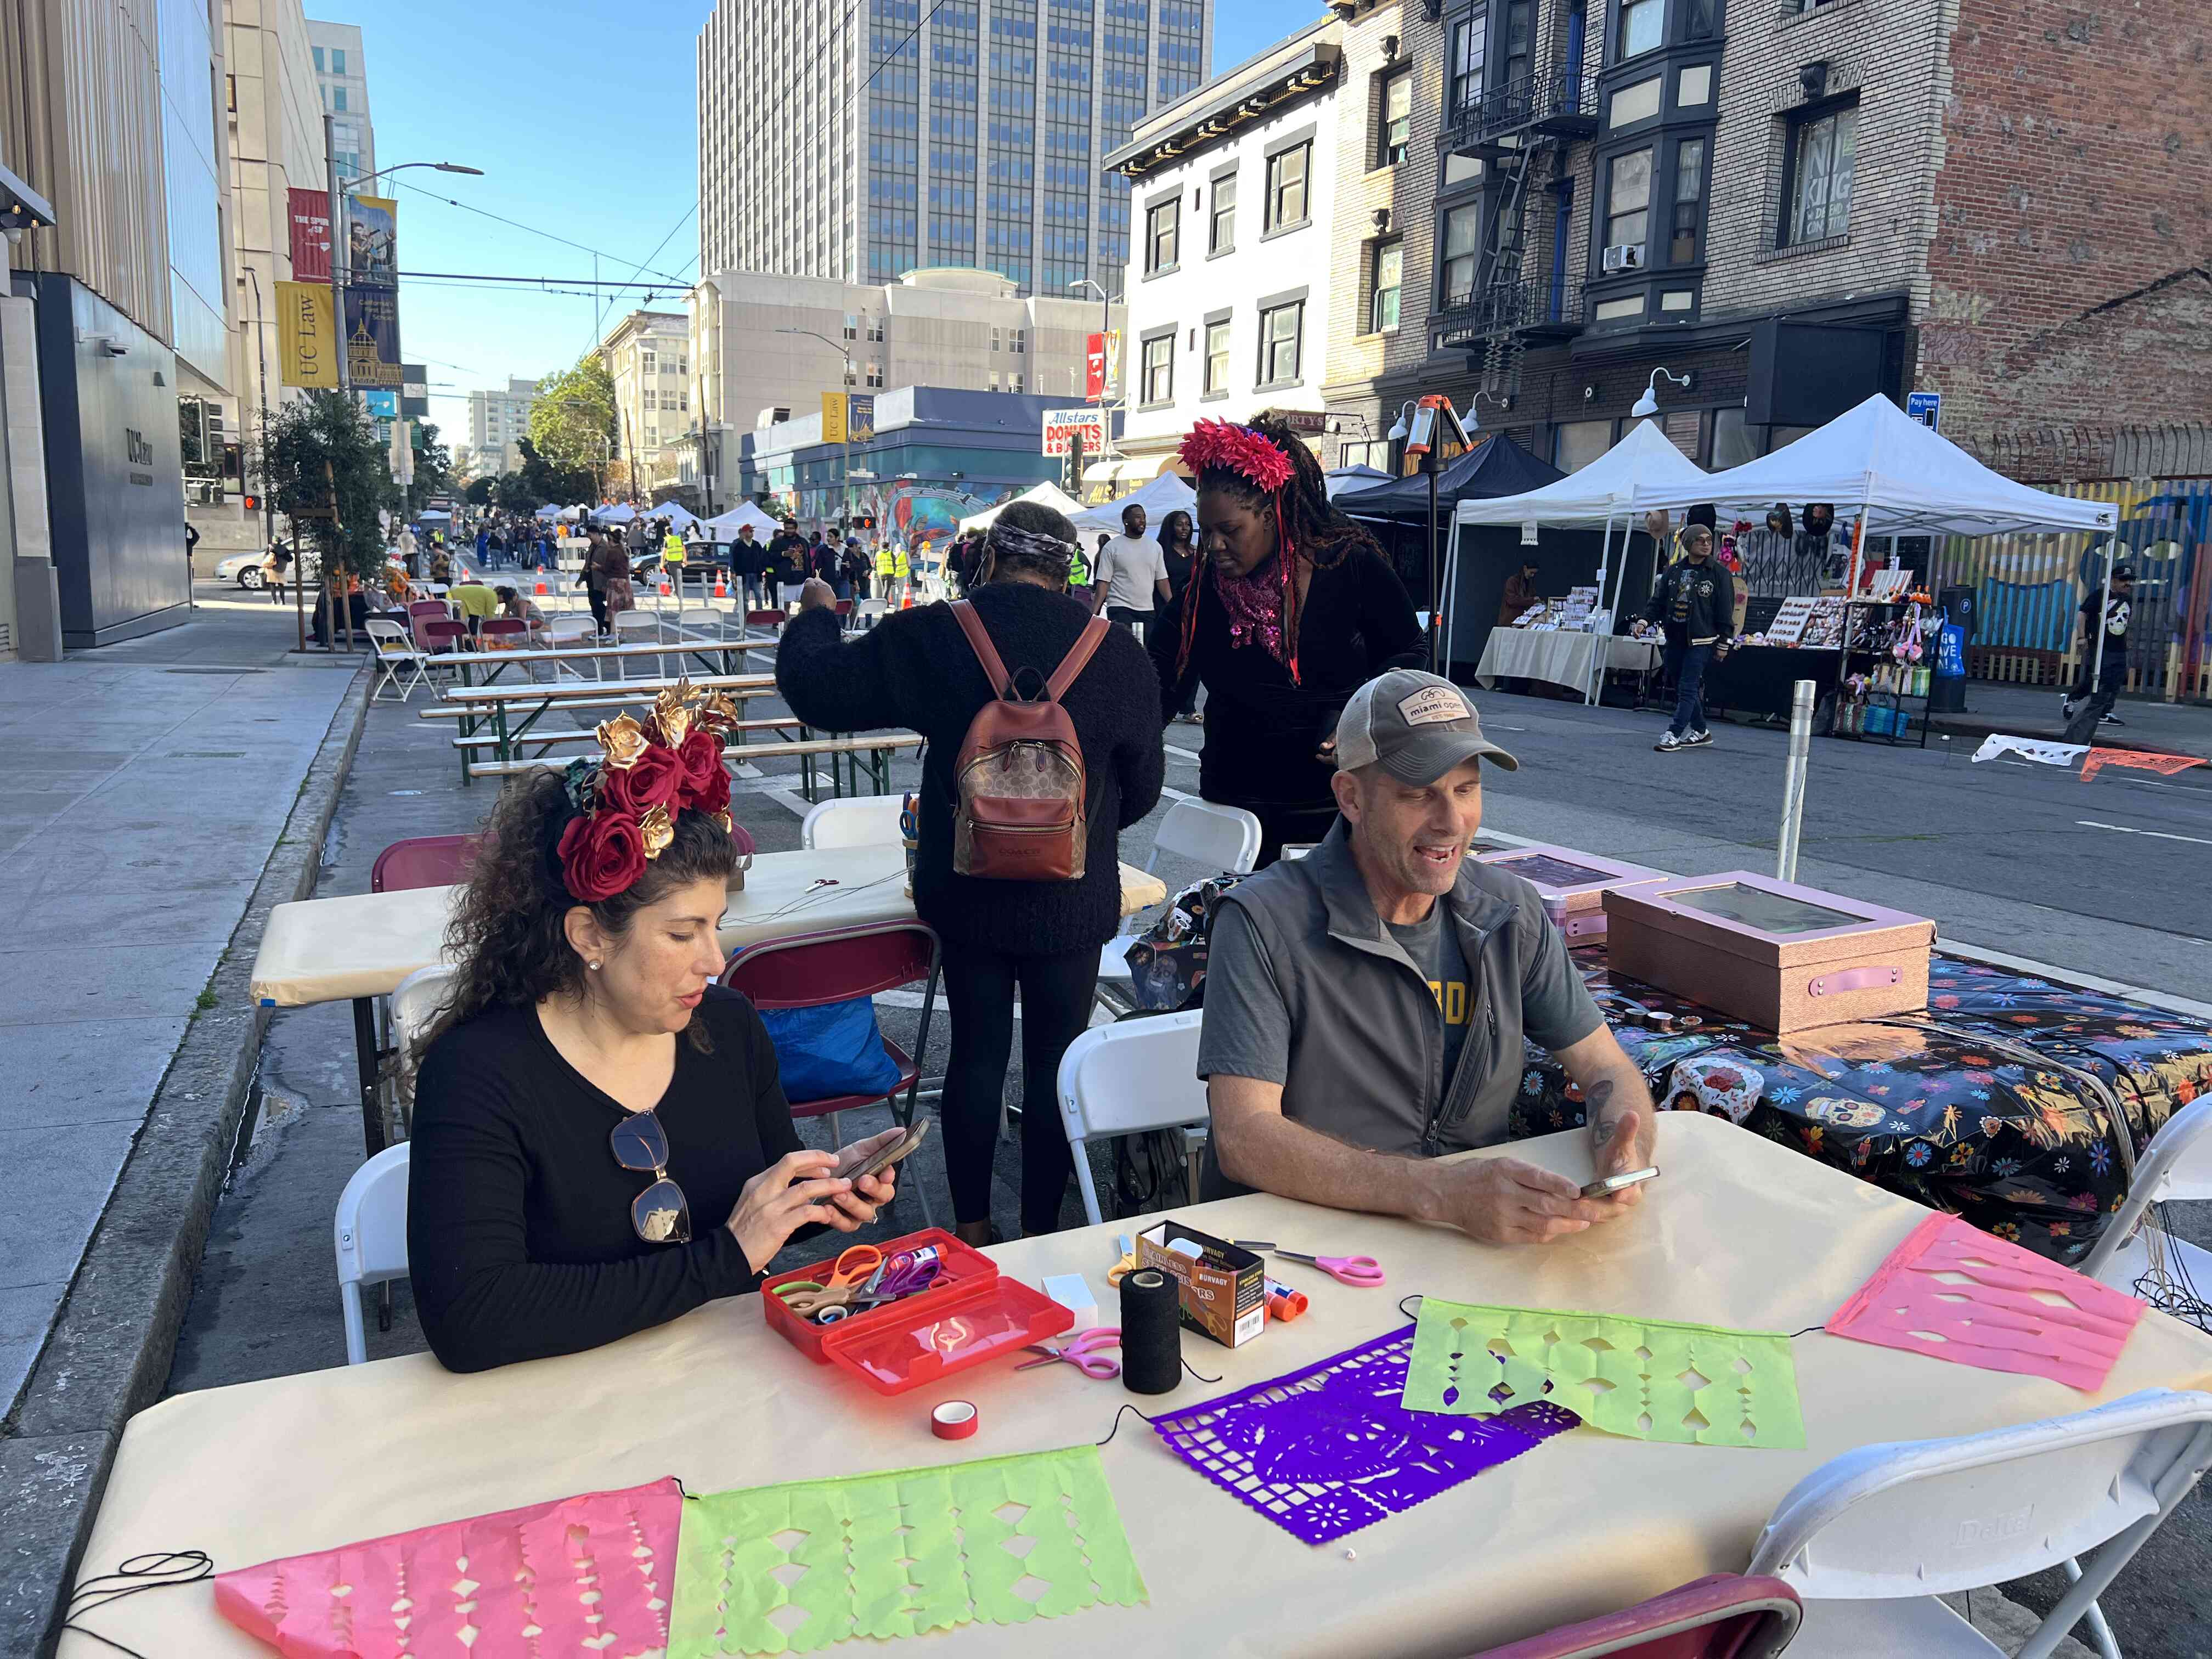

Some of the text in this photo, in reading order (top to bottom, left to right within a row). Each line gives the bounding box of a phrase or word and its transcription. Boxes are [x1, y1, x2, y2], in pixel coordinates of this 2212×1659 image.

[1815, 202, 1843, 219] DEEND
[295, 215, 308, 224] THE
[1807, 215, 1848, 235] CONTITU
[298, 294, 317, 338] Law
[298, 345, 319, 376] UC
[1911, 397, 1938, 407] Pay here
[830, 398, 839, 437] UC Law
[1049, 412, 1099, 424] Allstars
[1046, 442, 1101, 453] & BUERS
[1940, 632, 1956, 645] GO
[1938, 645, 1957, 657] AVE
[1410, 701, 1443, 717] miami
[1200, 1244, 1225, 1260] URVAGY
[1198, 1272, 1228, 1286] BURVAGY
